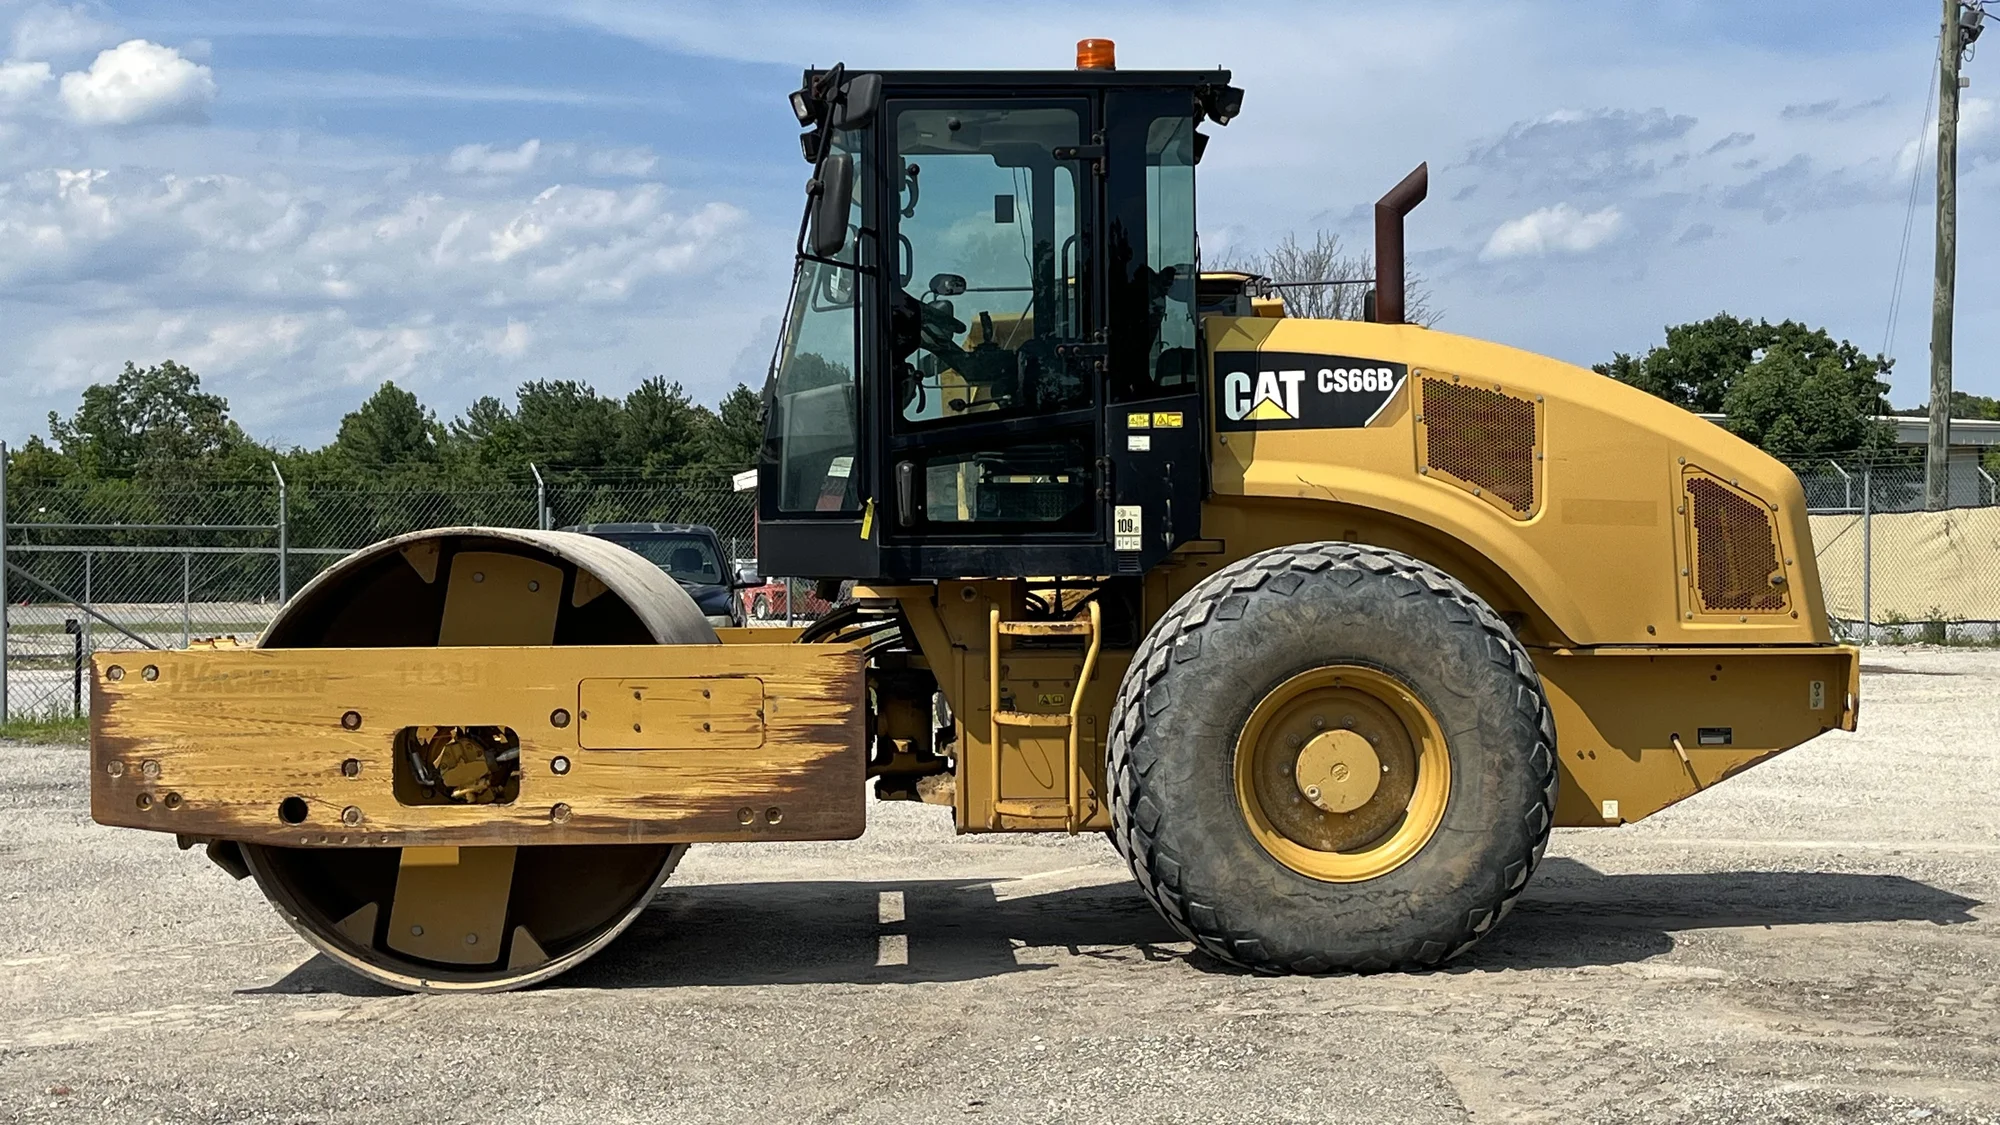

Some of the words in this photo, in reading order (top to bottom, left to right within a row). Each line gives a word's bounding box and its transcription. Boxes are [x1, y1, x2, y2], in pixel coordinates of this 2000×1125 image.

[1224, 370, 1305, 421] CAT
[1317, 368, 1394, 393] CS66B
[1117, 518, 1133, 533] 109
